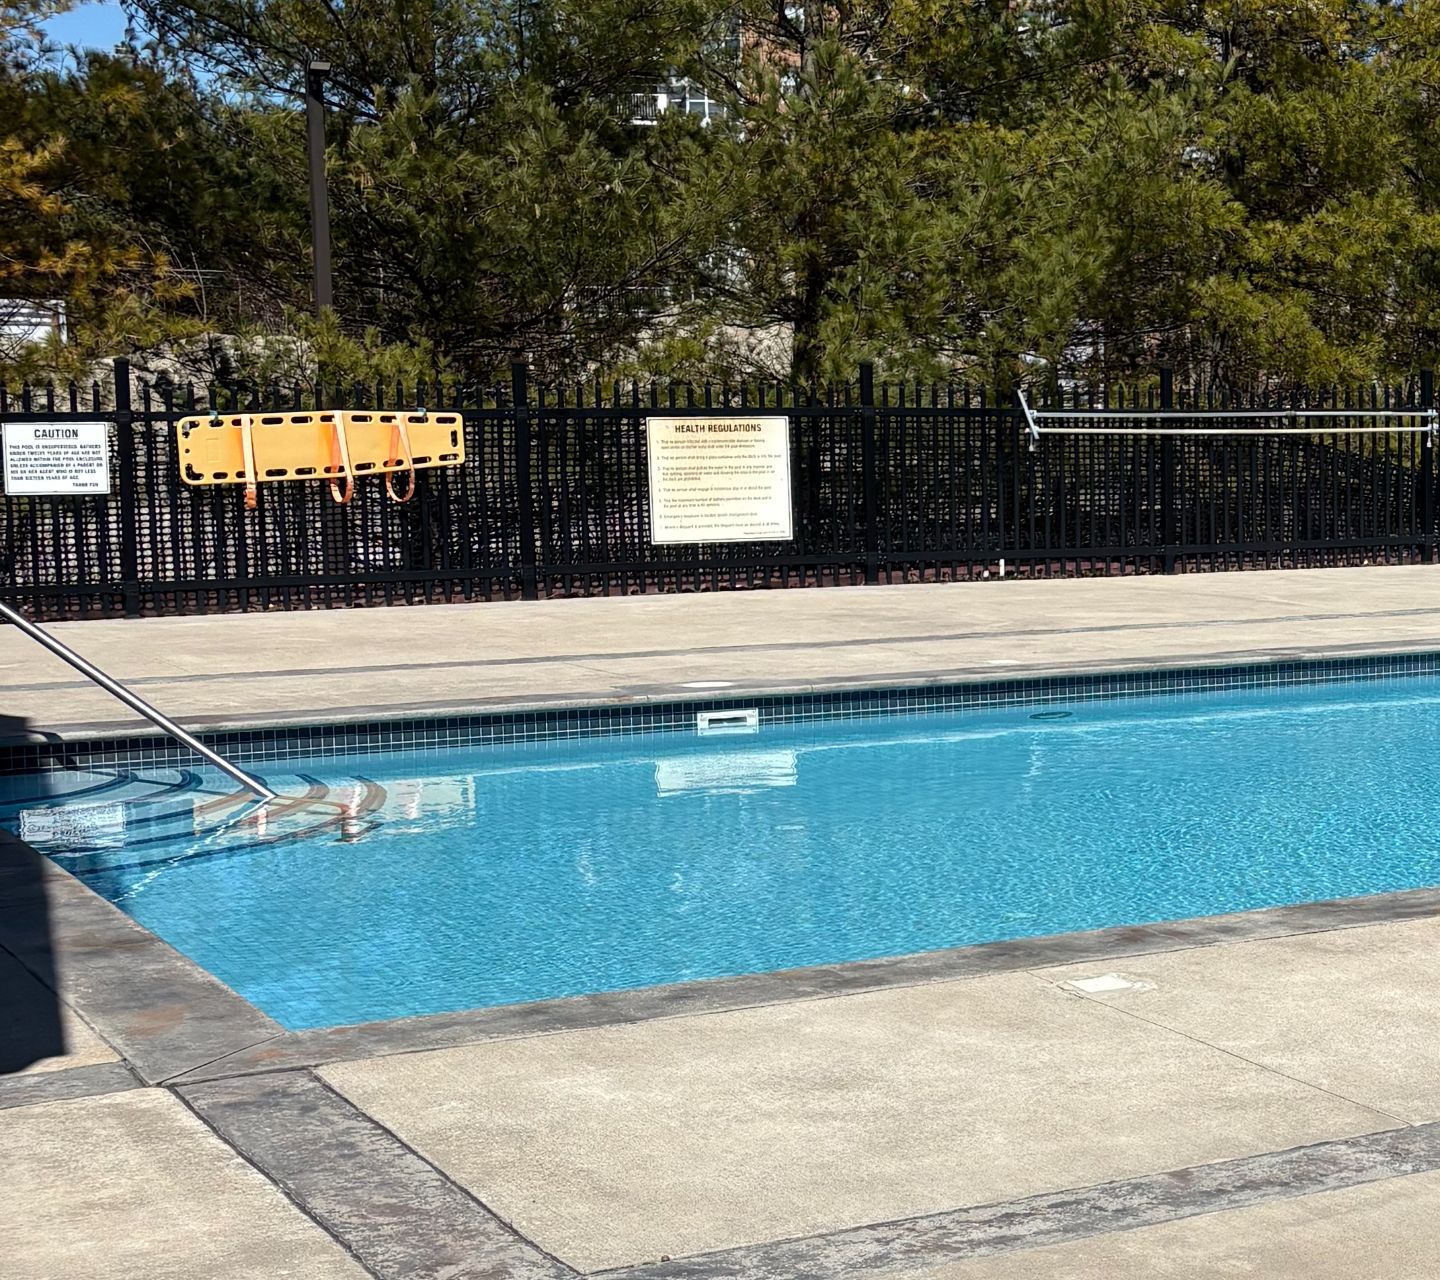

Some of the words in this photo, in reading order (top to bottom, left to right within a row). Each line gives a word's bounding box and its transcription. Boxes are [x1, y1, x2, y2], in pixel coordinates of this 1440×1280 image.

[675, 424, 705, 433] HEALTH
[708, 424, 762, 432] REGULATIONS
[34, 429, 78, 438] CAUTION
